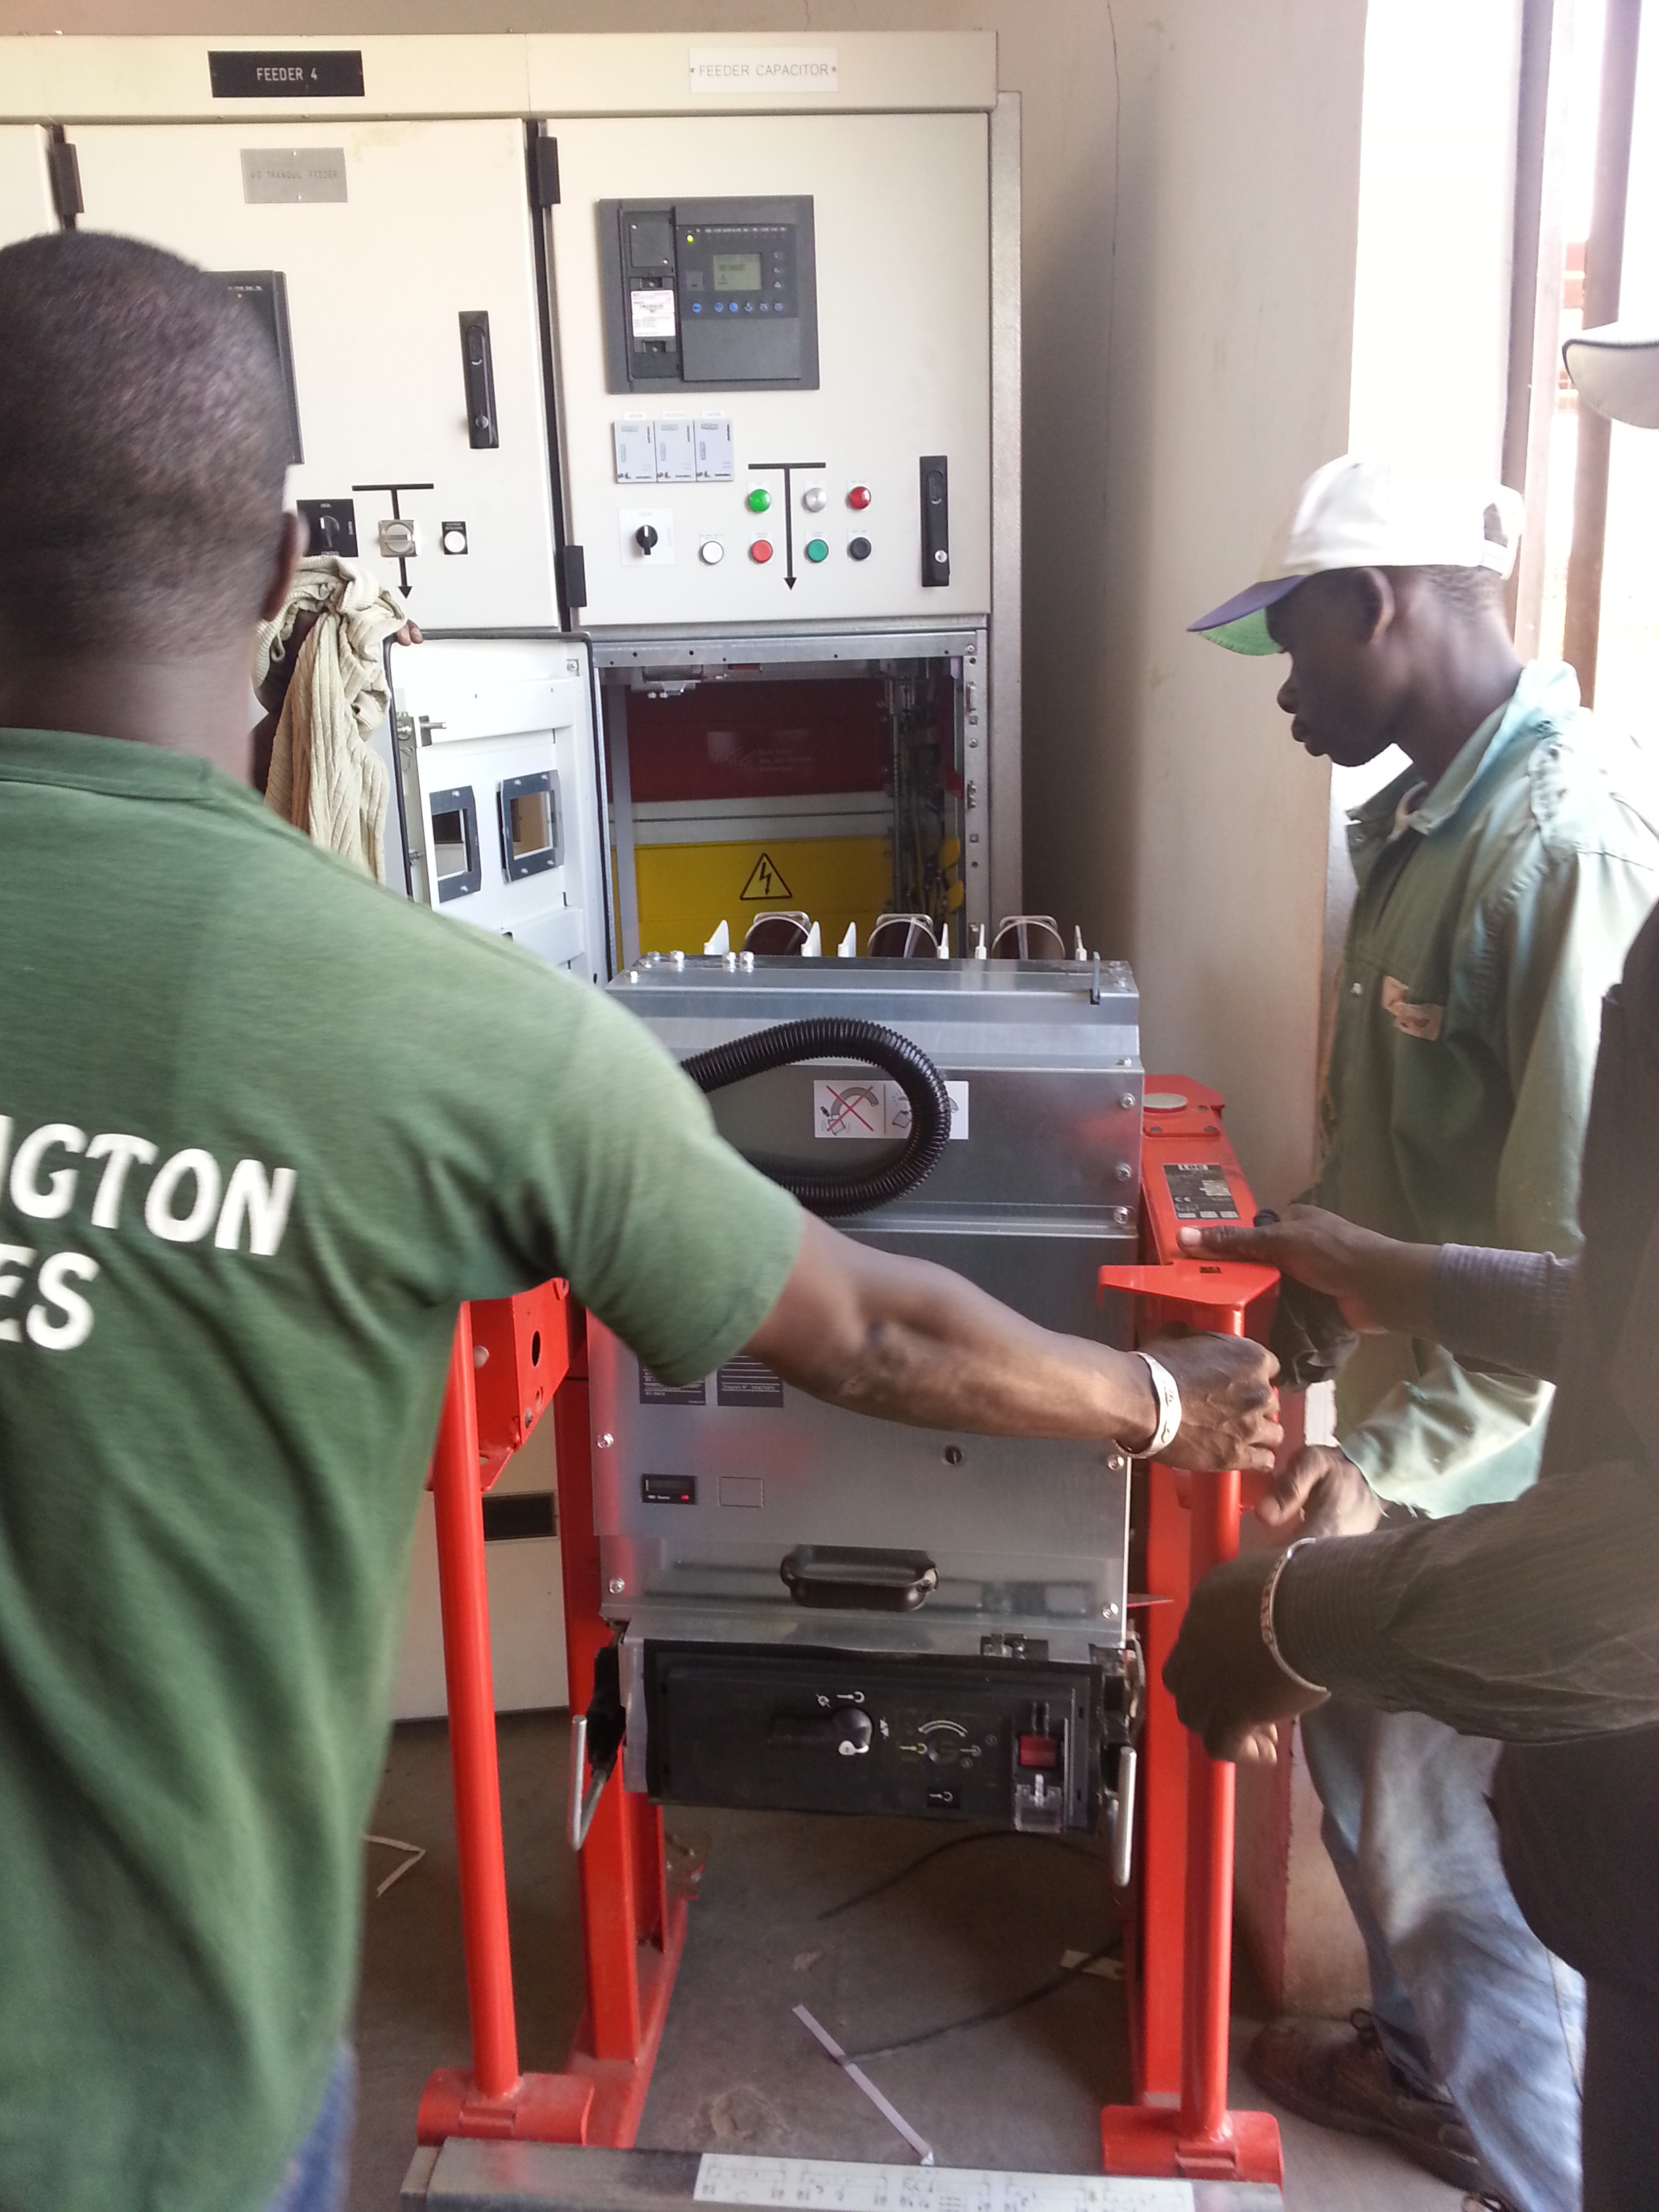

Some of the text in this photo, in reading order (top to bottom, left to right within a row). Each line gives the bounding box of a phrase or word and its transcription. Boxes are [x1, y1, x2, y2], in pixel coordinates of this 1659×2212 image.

[256, 67, 318, 81] FEEDER 4
[699, 64, 830, 77] FEEDER CAPACITOR
[267, 171, 302, 180] TRANQUIL
[309, 170, 338, 179] FEEDER
[0, 1242, 100, 1351] ES
